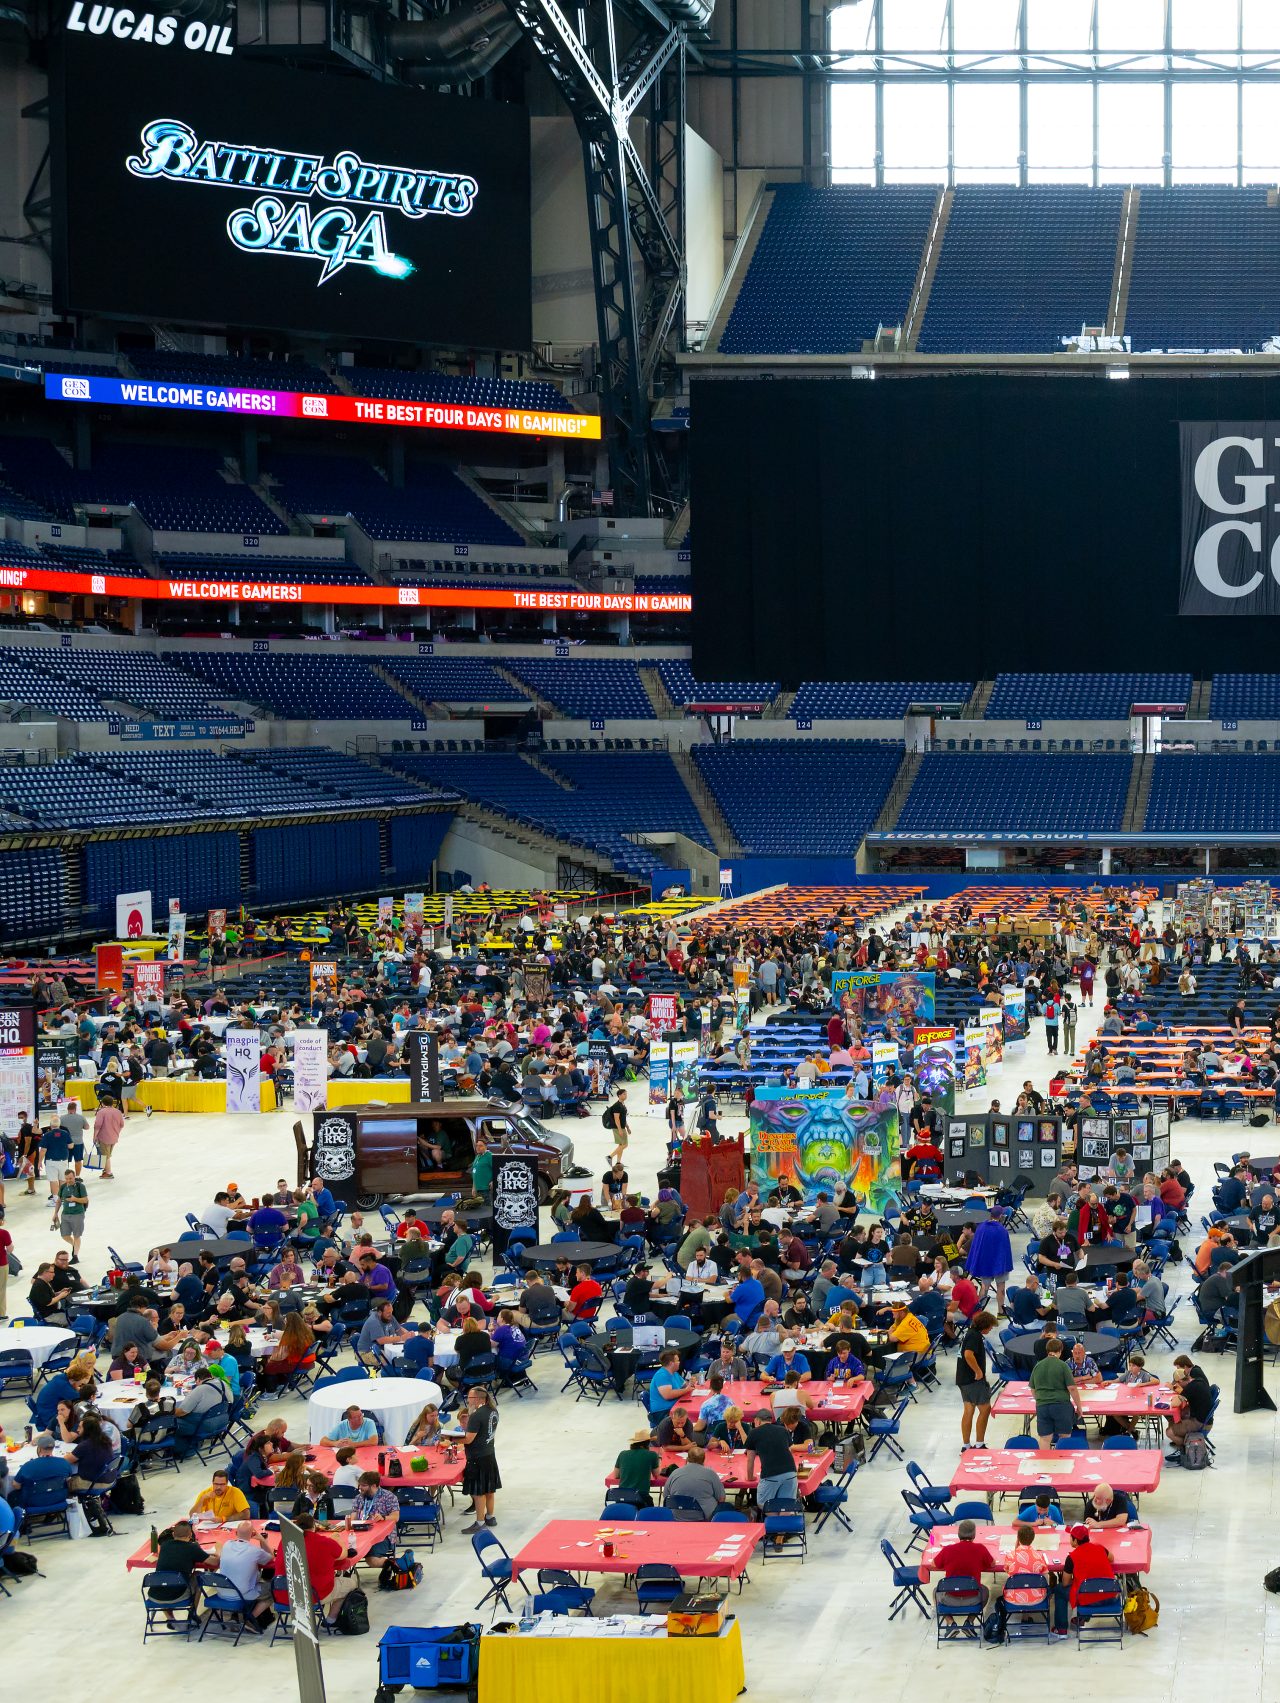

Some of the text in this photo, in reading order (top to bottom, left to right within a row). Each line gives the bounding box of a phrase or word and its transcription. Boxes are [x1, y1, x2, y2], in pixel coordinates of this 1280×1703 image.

[67, 2, 235, 55] LUCAS OIL
[126, 118, 478, 218] BATTLE SPIRITS
[227, 195, 395, 286] SAGA
[121, 383, 276, 411] WELCOME GAMERS!
[355, 402, 383, 419] THE
[387, 405, 423, 422] BEST
[426, 408, 464, 425] FOUR
[467, 411, 502, 428] DAYS
[505, 414, 520, 429] IN
[678, 553, 691, 561] 323
[169, 583, 301, 600] WELCOME GAMERS!
[514, 593, 691, 610] THE BEST FOUR DAYS IN GAMIN
[254, 642, 268, 650] 220
[420, 645, 433, 653] 221
[556, 647, 569, 655] 222
[153, 725, 175, 736] TEXT
[136, 965, 160, 974] ZOMBIE
[312, 964, 335, 977] MASKS
[137, 973, 160, 982] WORLD
[835, 974, 881, 997] KEYFORGE
[651, 998, 674, 1007] ZOMBIE
[651, 1008, 674, 1018] WORLD
[0, 1028, 20, 1043] HQ
[227, 1036, 259, 1046] magpie
[917, 1030, 952, 1046] KEYFORGE
[235, 1048, 251, 1060] HQ
[420, 1037, 430, 1098] DEMIPLANE
[325, 1126, 347, 1136] DCC
[758, 1131, 797, 1140] DUNGEON
[324, 1135, 347, 1144] RPG
[503, 1170, 528, 1181] DCC
[503, 1180, 528, 1191] RPG
